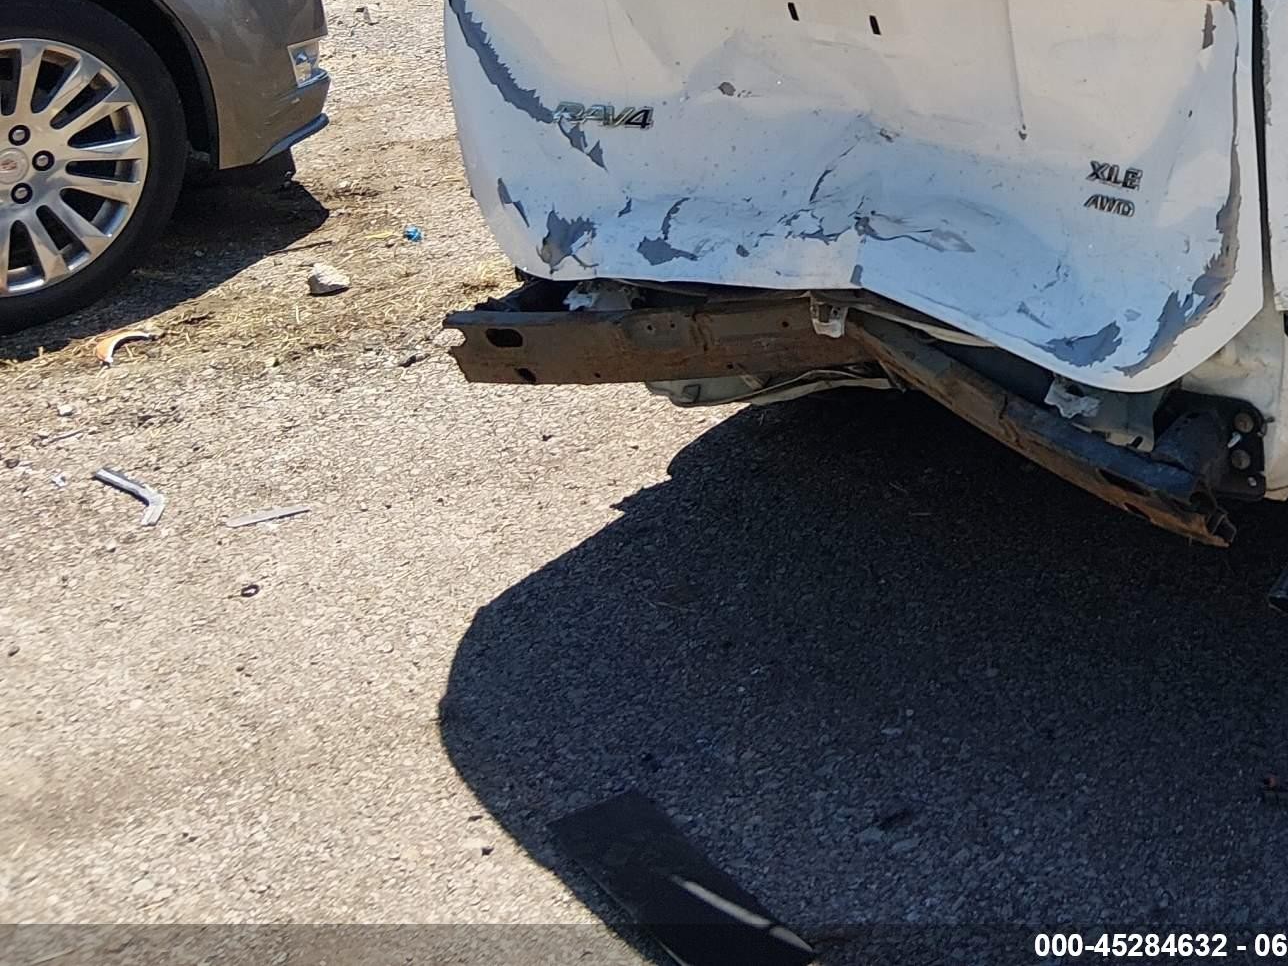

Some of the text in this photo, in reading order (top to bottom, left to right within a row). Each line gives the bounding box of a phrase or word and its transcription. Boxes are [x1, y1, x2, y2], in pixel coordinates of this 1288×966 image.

[553, 101, 654, 130] RAV4
[1086, 160, 1143, 190] XLE
[1083, 193, 1135, 217] AWD
